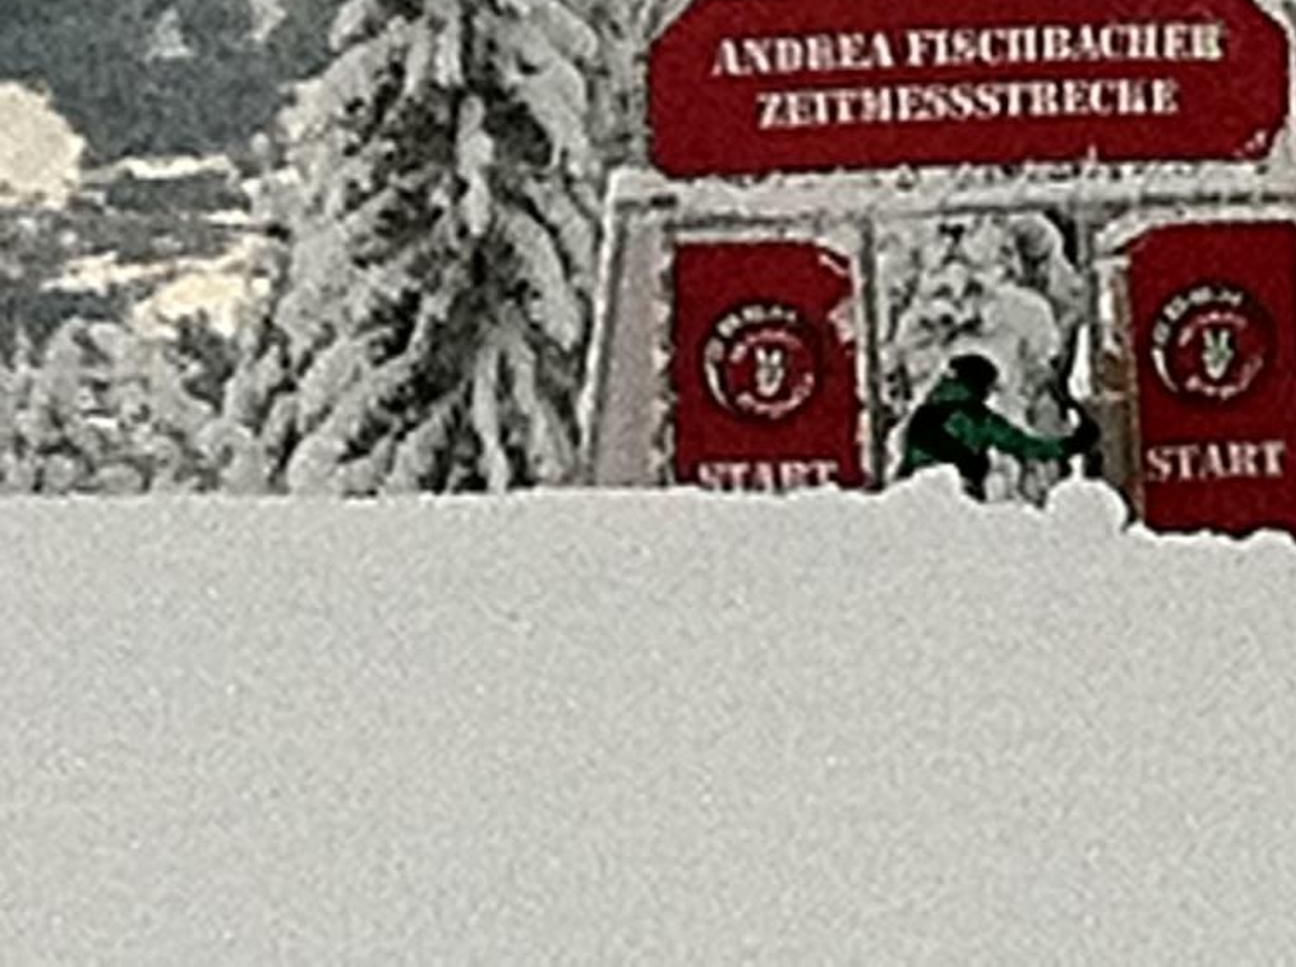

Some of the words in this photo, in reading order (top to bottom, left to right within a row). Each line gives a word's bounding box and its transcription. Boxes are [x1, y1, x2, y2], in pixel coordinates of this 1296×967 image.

[711, 34, 893, 78] ANDREA
[905, 20, 1227, 67] FISCHBACHER
[756, 78, 1181, 130] ZEITMESSSTRECKE
[1146, 439, 1286, 482] START
